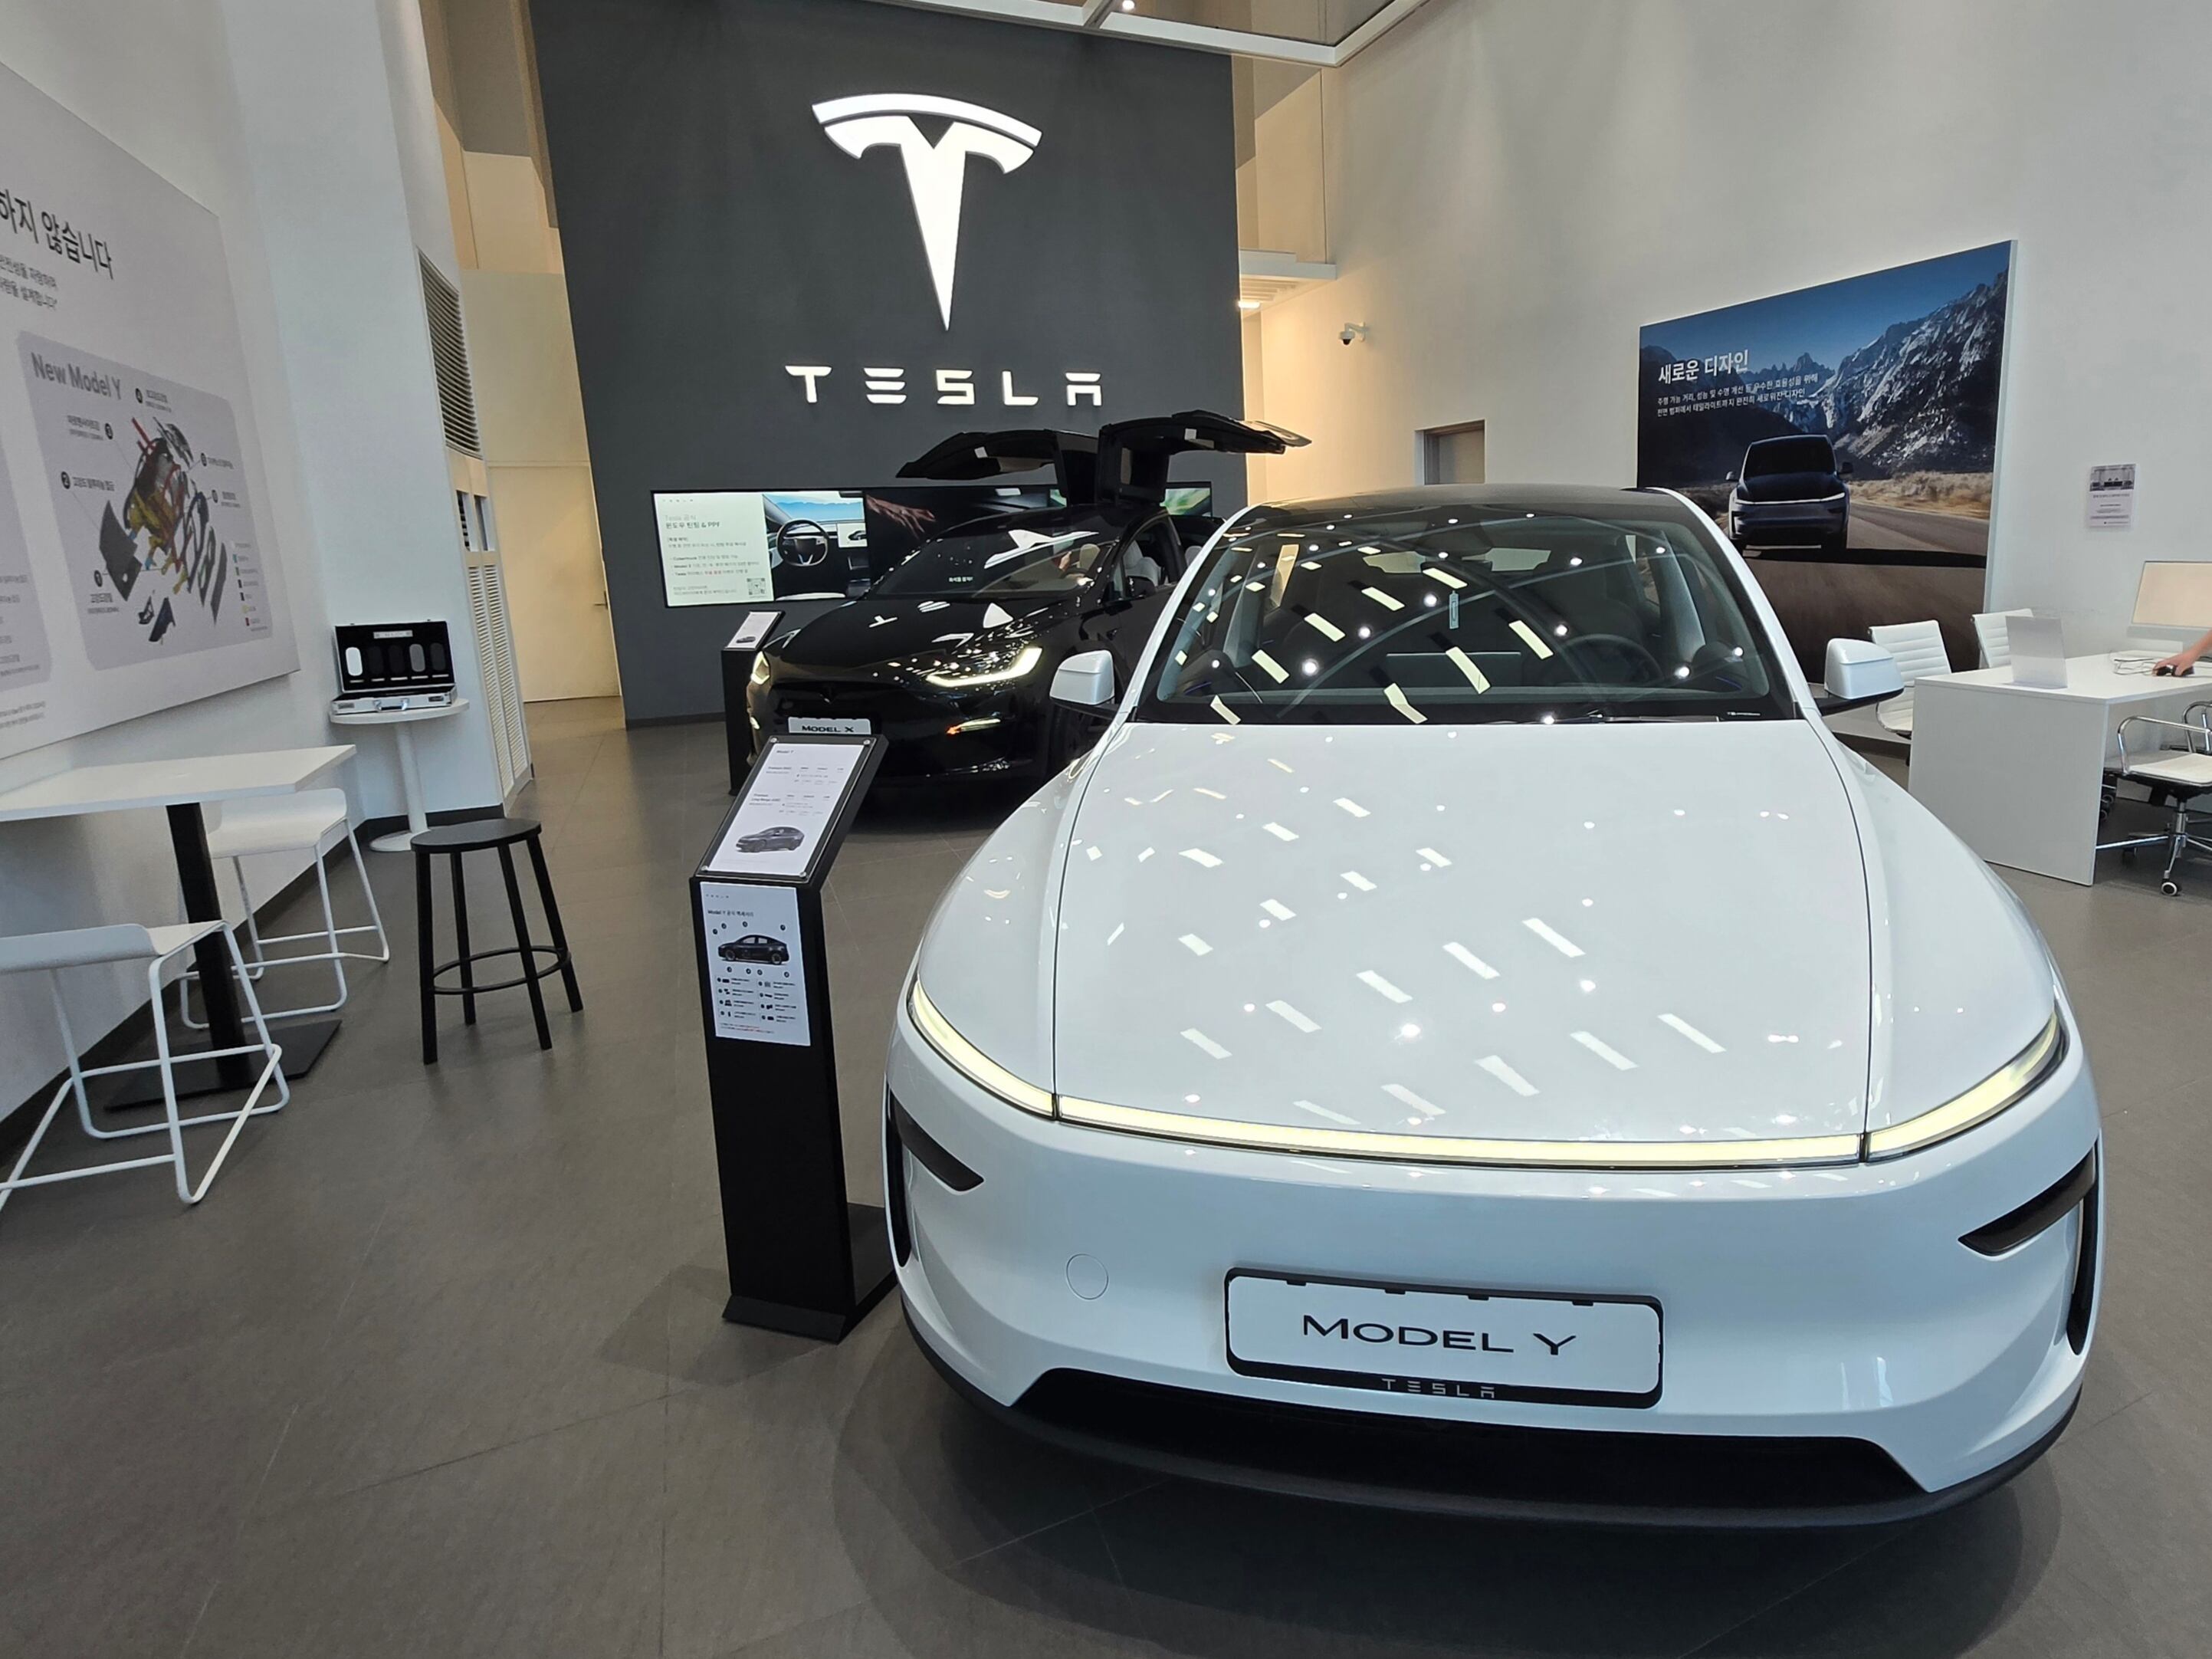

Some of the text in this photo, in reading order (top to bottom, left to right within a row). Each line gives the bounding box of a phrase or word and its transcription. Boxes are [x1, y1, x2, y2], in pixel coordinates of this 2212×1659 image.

[41, 212, 113, 280] 않습니다
[31, 352, 66, 383] New
[67, 363, 112, 399] Model
[111, 378, 122, 400] Y
[785, 365, 1102, 406] TESLA
[1659, 349, 1749, 384] 새로운 디자인
[1803, 373, 1818, 383] 위해
[1784, 388, 1805, 398] 디자인
[1303, 1314, 1577, 1355] MODEL Y
[1381, 1378, 1495, 1398] TESLA
